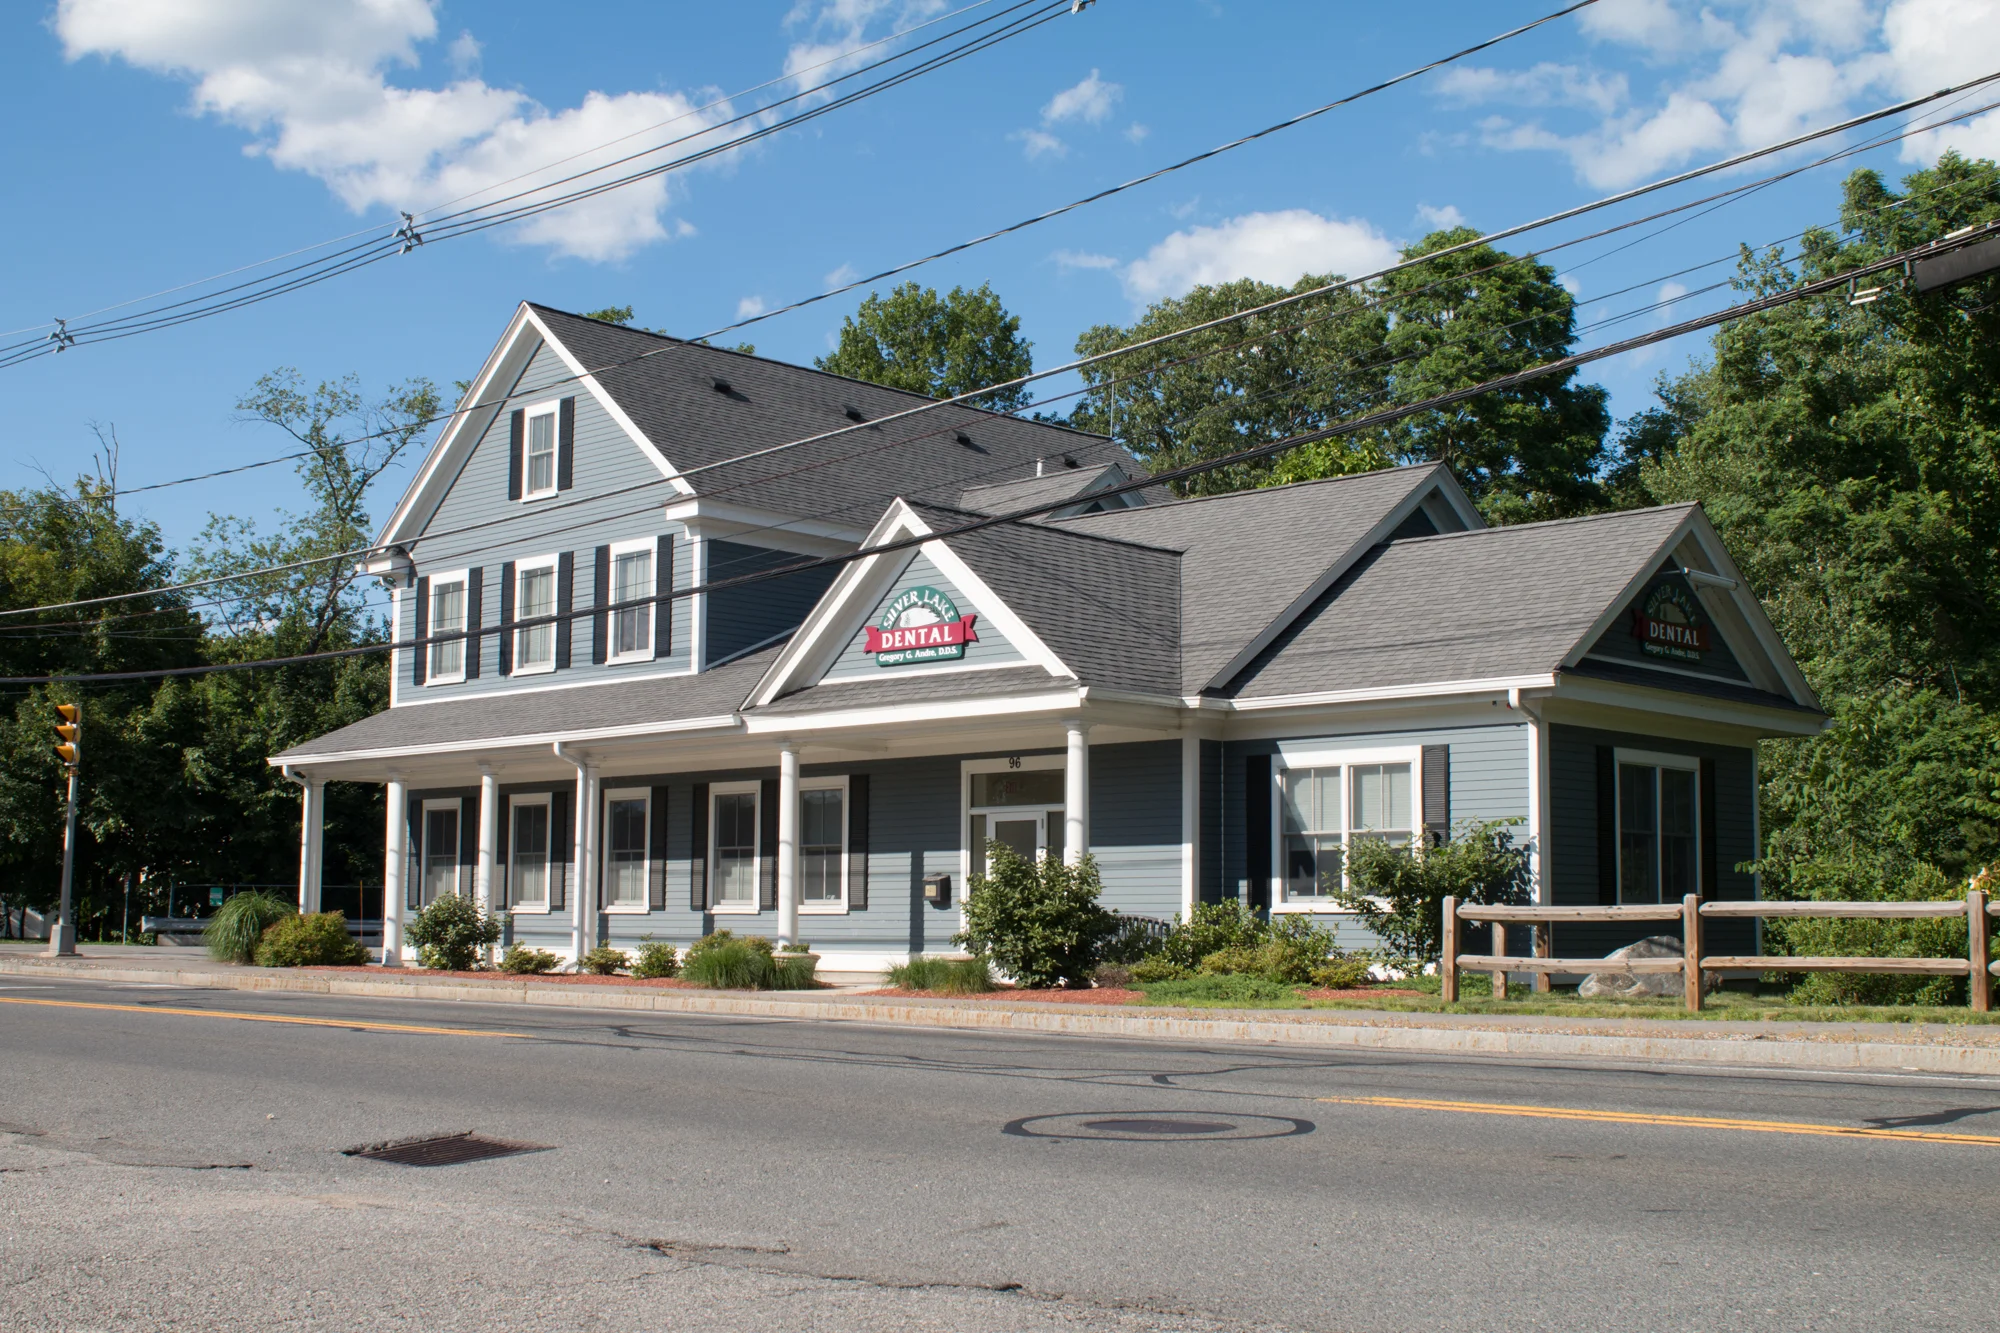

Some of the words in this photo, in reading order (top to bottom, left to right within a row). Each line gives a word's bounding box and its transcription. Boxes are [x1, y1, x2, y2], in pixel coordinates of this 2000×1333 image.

[884, 590, 919, 629] SILVER
[923, 590, 954, 622] LAKE
[882, 626, 953, 649] DENTAL
[1650, 621, 1699, 646] DENTAL
[879, 653, 904, 662] Gregory
[906, 651, 913, 659] G.
[1009, 757, 1021, 768] 96
